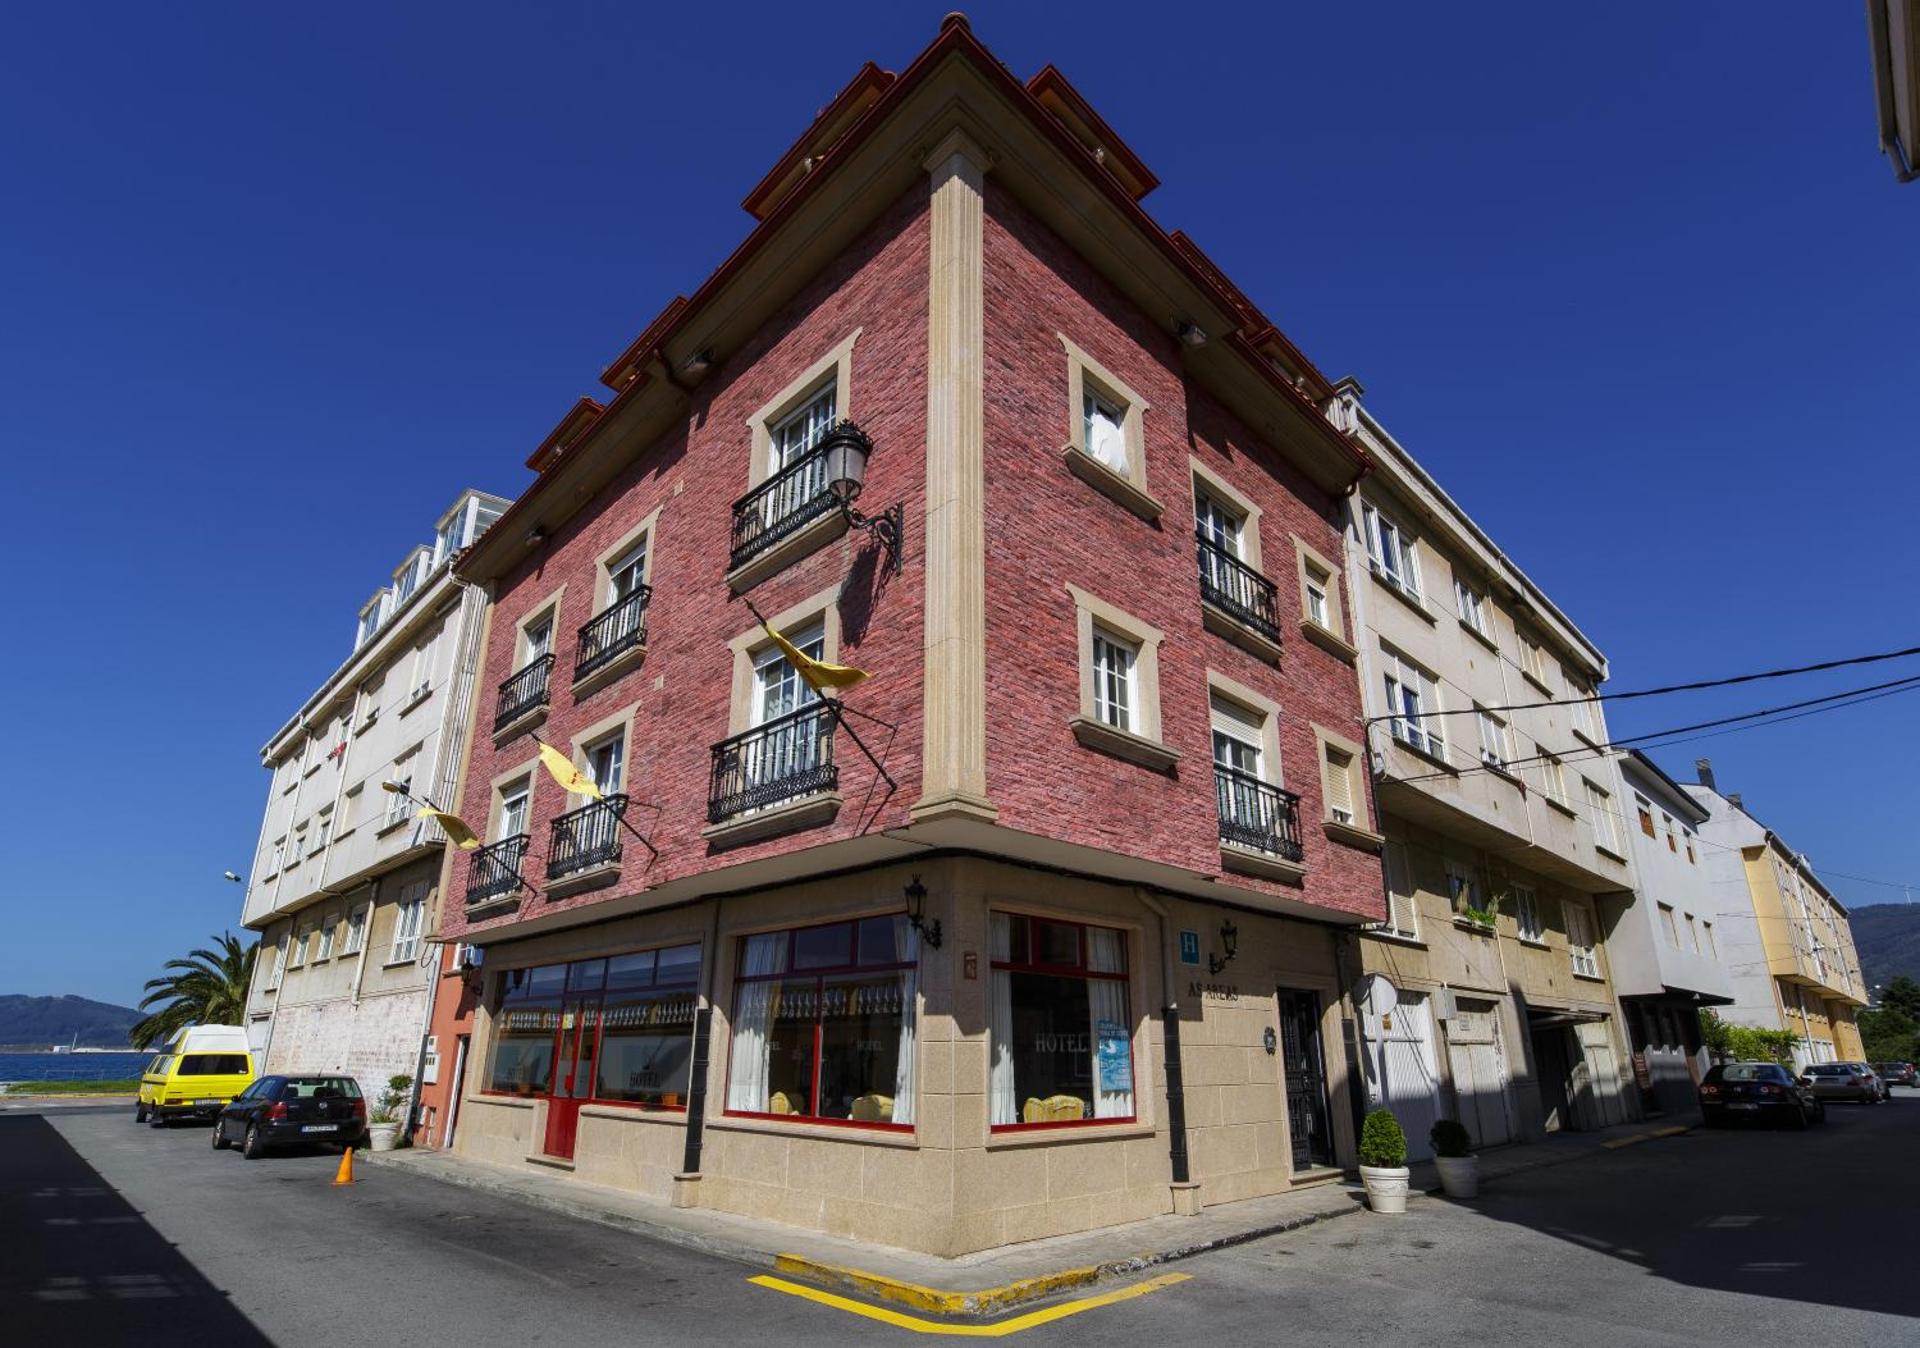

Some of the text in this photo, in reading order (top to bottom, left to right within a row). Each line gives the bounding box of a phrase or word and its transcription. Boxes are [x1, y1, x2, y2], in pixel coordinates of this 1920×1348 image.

[1184, 933, 1195, 953] H
[1188, 982, 1203, 997] AS
[1034, 1032, 1089, 1053] HOTEL
